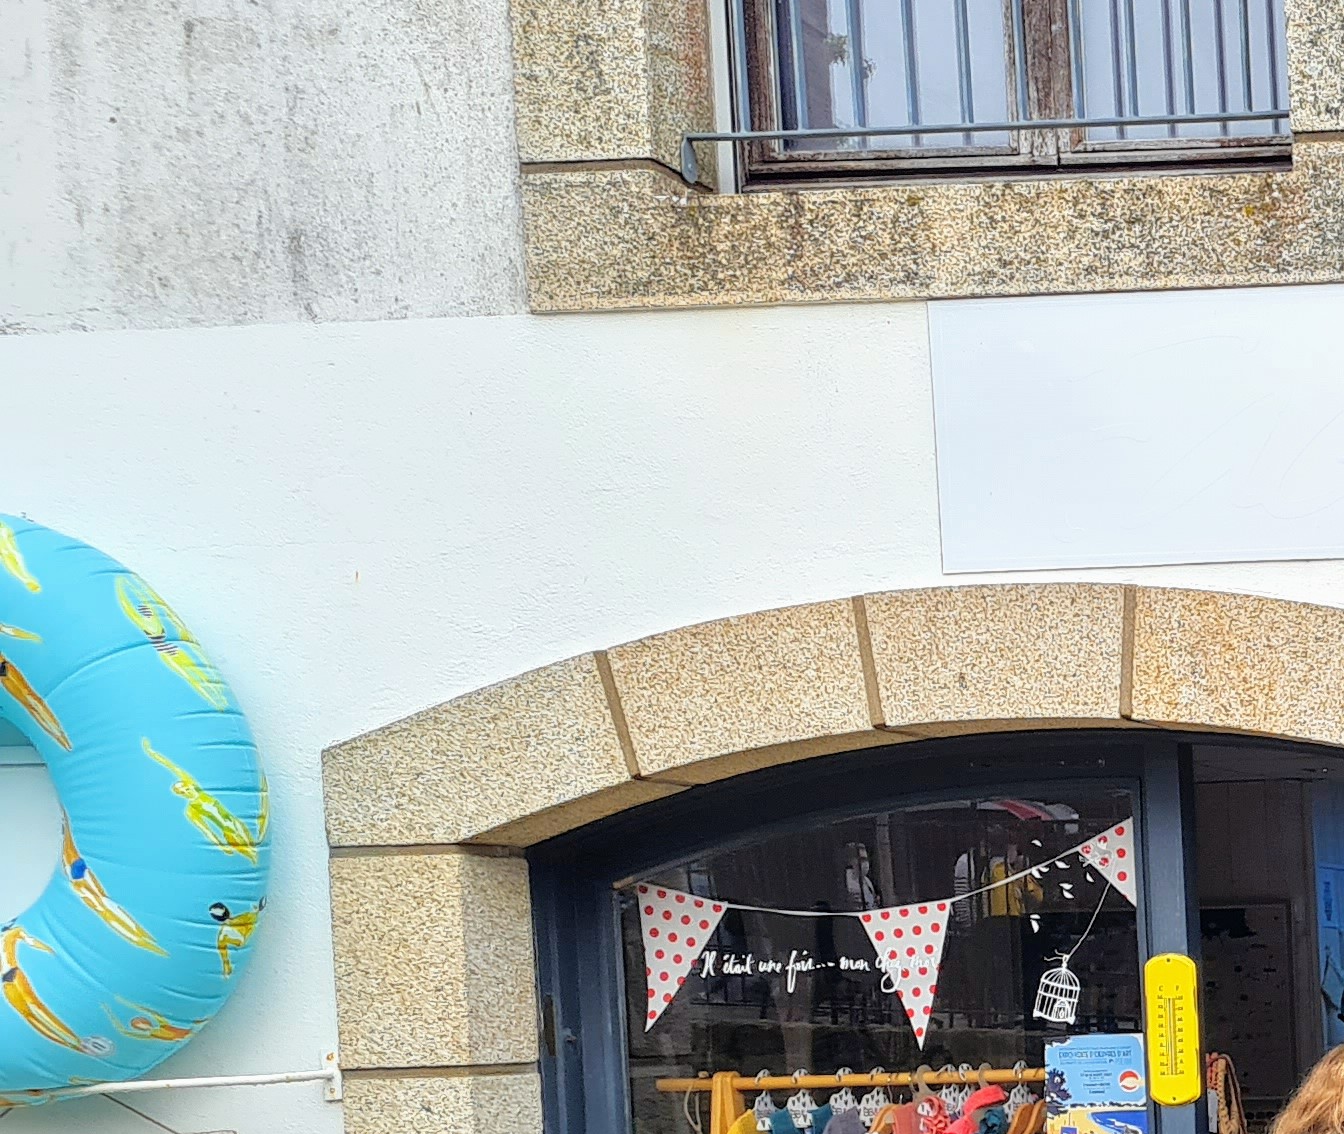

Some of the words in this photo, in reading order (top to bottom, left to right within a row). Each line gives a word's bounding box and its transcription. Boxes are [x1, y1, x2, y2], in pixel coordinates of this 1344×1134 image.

[700, 950, 716, 979] Il
[722, 953, 755, 975] était
[758, 960, 782, 973] une
[840, 957, 871, 972] mon
